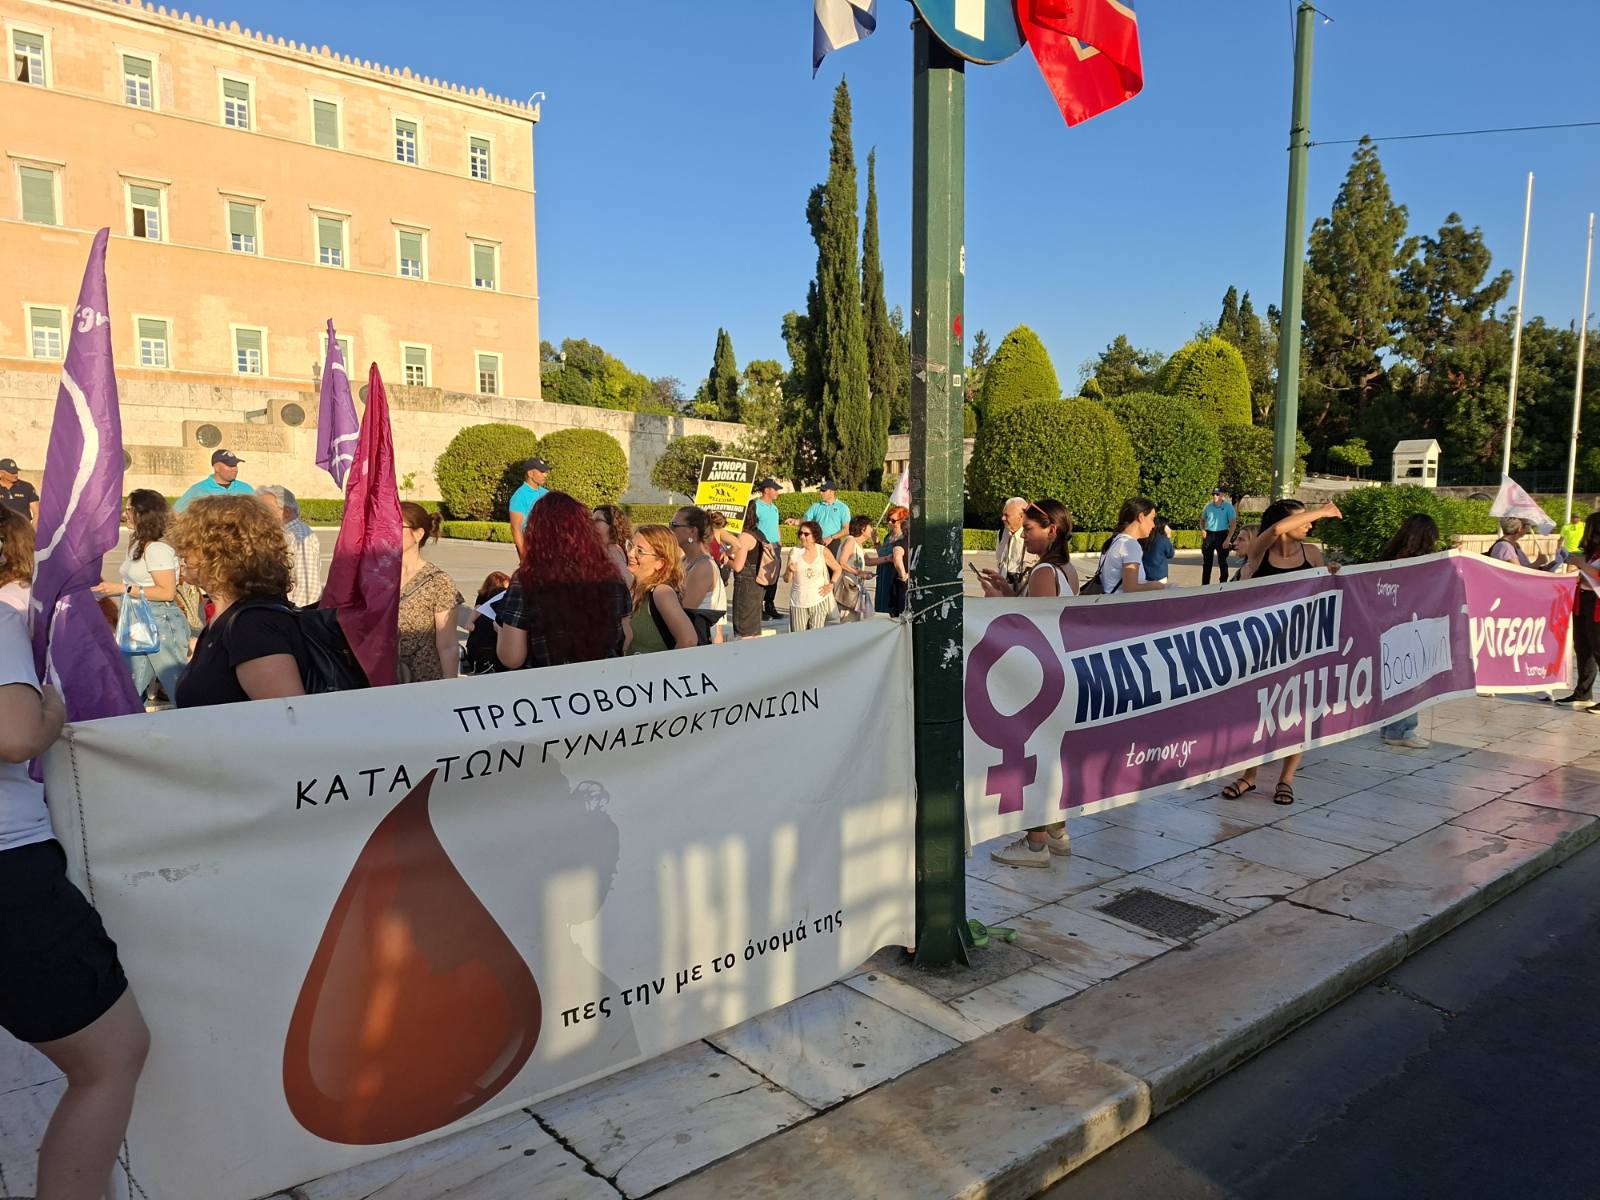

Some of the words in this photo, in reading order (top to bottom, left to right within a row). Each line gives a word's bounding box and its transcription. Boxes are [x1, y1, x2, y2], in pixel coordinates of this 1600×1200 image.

[707, 471, 747, 482] ΑΝΟΙΧΤΑ
[712, 461, 747, 472] ΣΥΝΟΡΑ
[1071, 641, 1162, 724] ΜΑΣ
[1158, 594, 1337, 701] ΣΚΟΤΩΝΟΥΝ
[1252, 637, 1373, 747] καμία
[453, 672, 718, 733] ΠΡΩΤΟΒΟΥΛΙΑ
[296, 764, 412, 810] ΚΑΤΑ
[436, 745, 524, 783] ΤΩΝ
[541, 687, 820, 764] ΓΥΝΑΙΚΟΚΤΟΝΙΩΝ
[1125, 738, 1198, 768] tomov.gr
[561, 996, 612, 1027] πες
[620, 977, 665, 1006] την
[676, 964, 703, 993] με
[711, 952, 736, 974] το
[743, 920, 808, 960] όνομά
[813, 909, 843, 935] της
